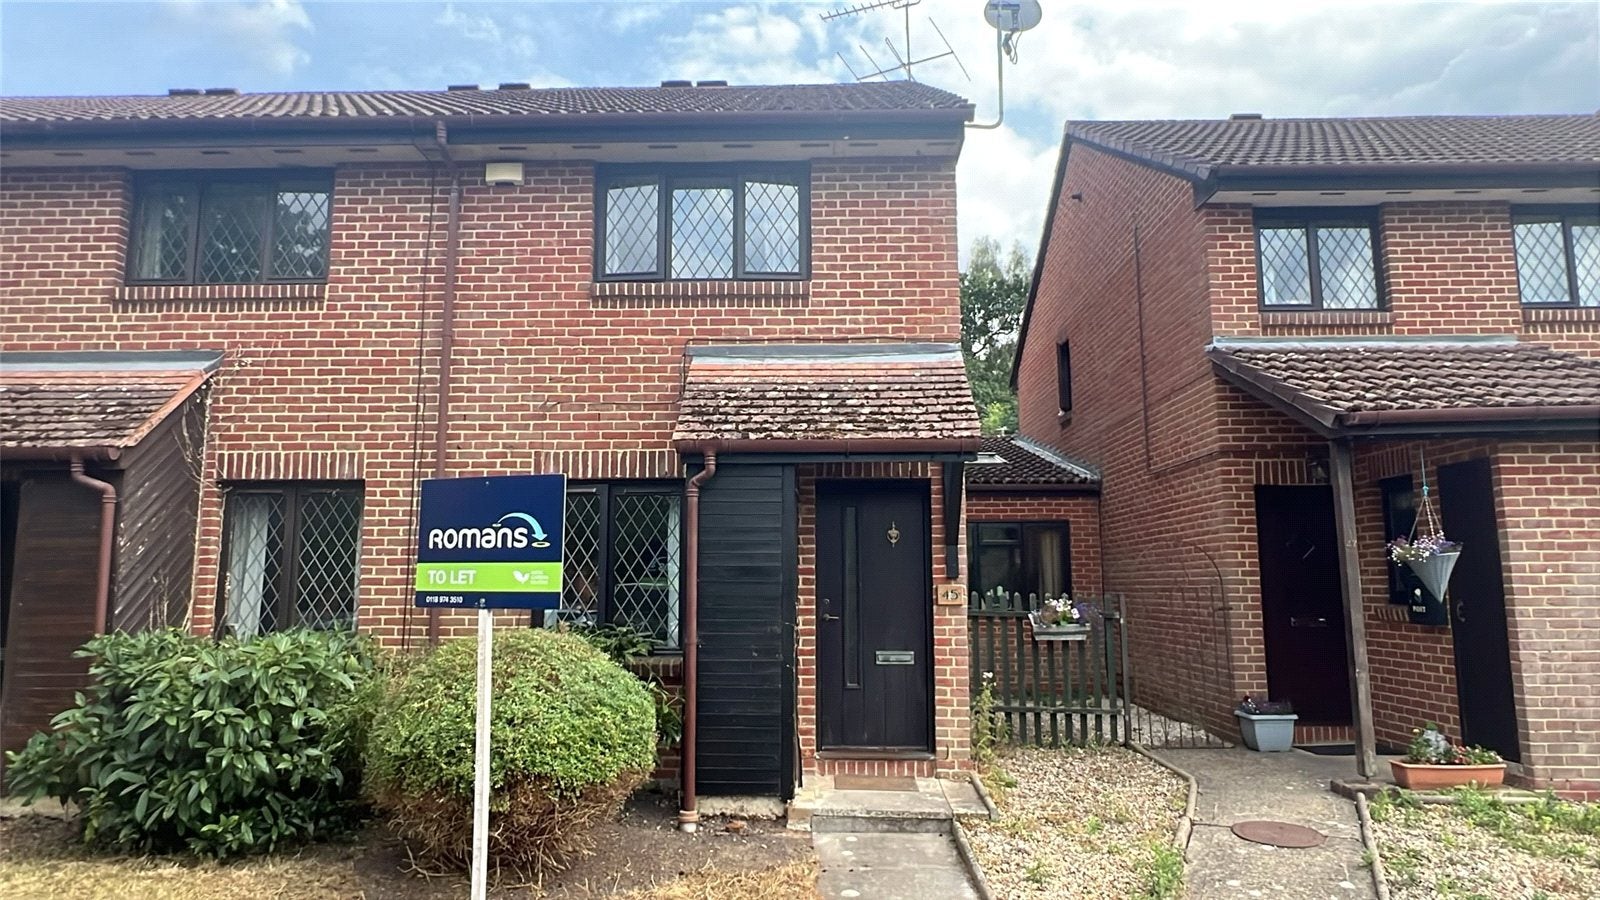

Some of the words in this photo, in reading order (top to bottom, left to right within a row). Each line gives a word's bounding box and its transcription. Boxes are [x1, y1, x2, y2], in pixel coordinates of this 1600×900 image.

[428, 570, 446, 585] TO
[450, 570, 476, 585] LET
[942, 590, 959, 600] 45
